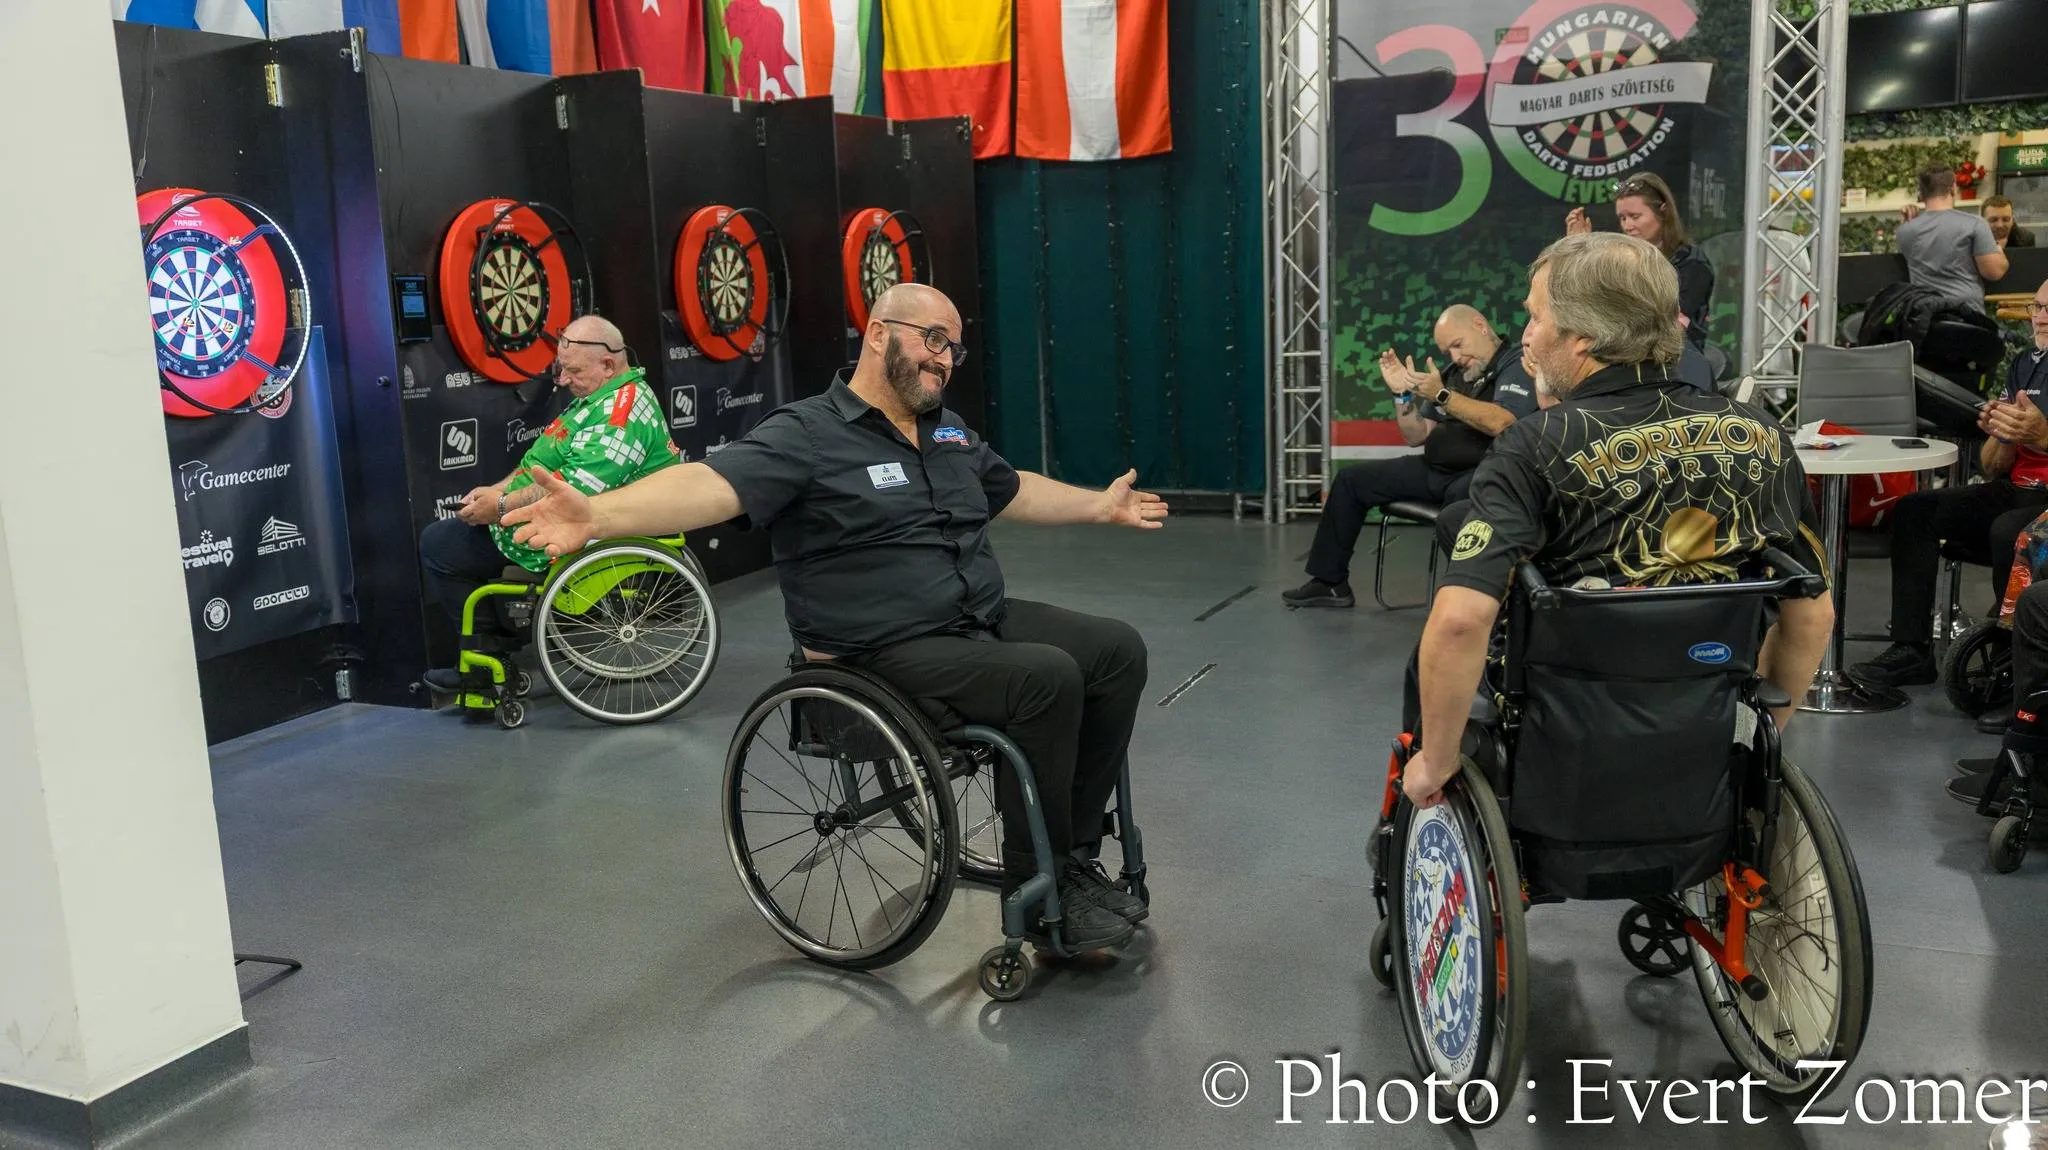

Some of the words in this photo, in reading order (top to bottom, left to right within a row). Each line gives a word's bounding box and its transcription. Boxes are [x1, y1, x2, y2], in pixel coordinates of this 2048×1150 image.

[1526, 10, 1670, 65] HUNGARIAN
[1519, 95, 1562, 113] MAGYAR
[1569, 86, 1605, 106] DARTS
[1611, 78, 1675, 98] SZÖVETSÉG
[1523, 130, 1568, 171] DARTS
[1572, 117, 1675, 177] FEDERATION
[724, 393, 763, 408] Gamecenter
[1568, 414, 1781, 489] HORIZON
[199, 463, 291, 490] Gamecenter
[1613, 454, 1763, 500] DARTS
[182, 553, 223, 570] ravel
[257, 538, 306, 556] BELOTTI
